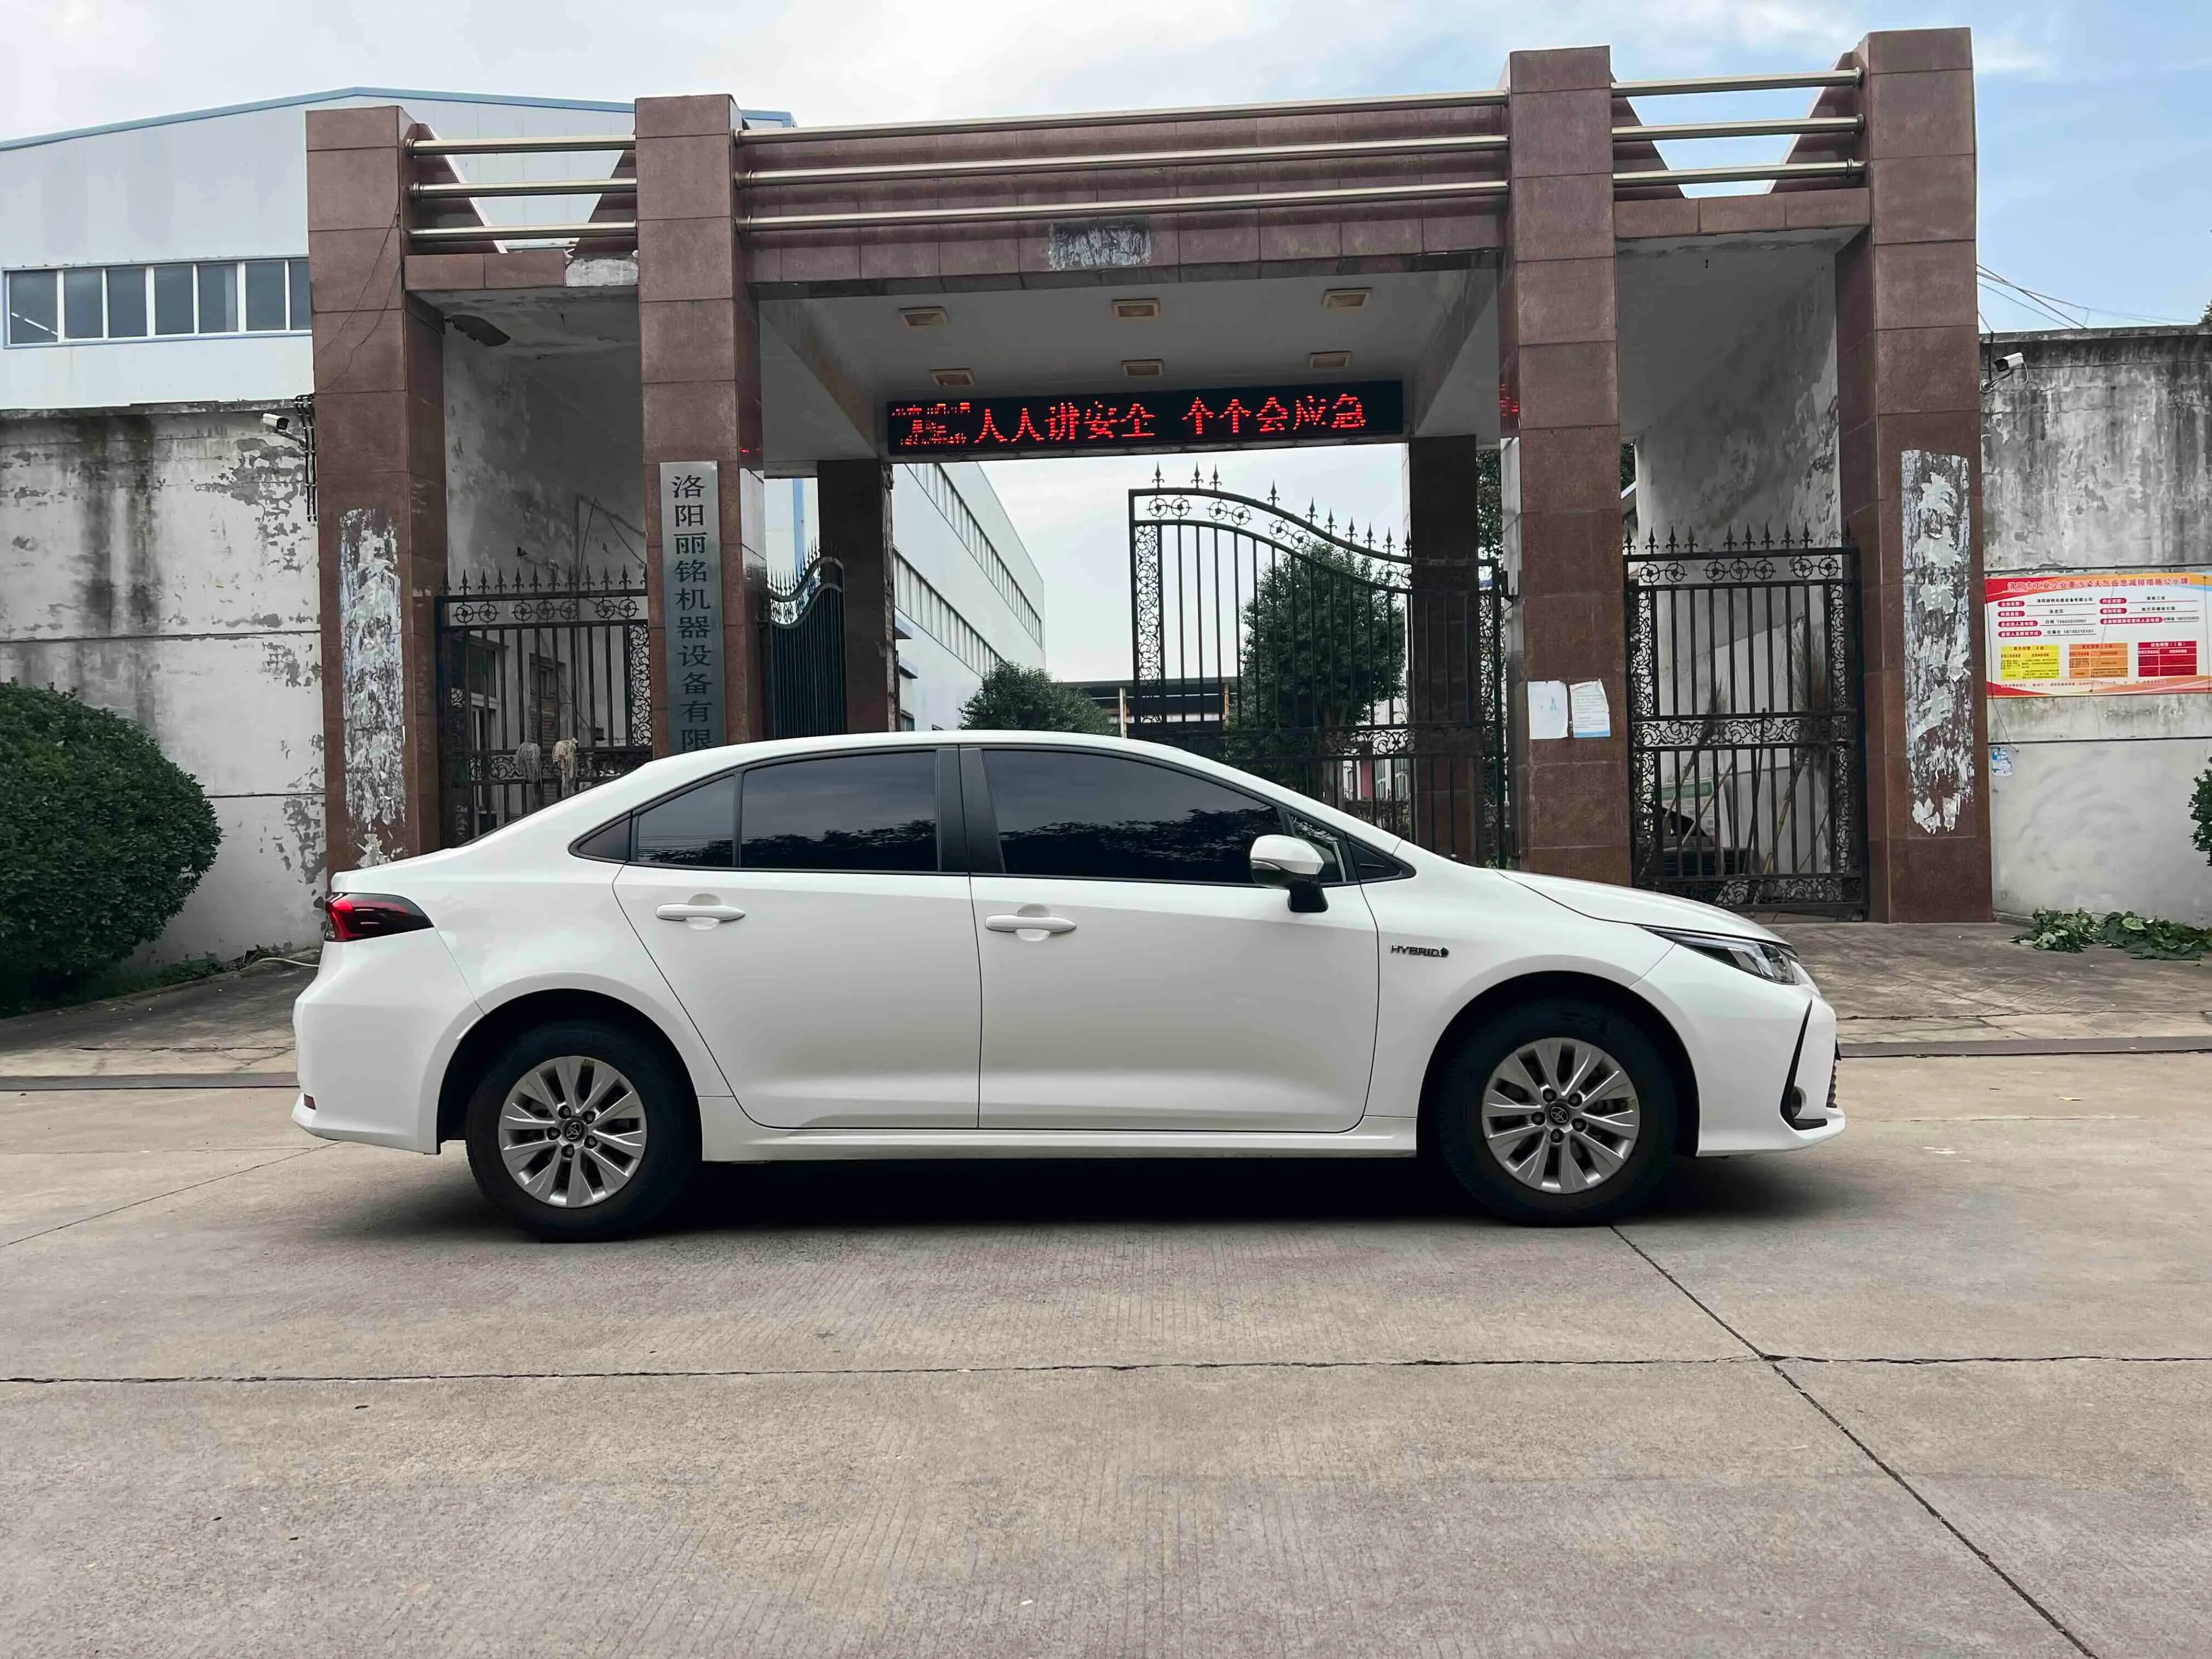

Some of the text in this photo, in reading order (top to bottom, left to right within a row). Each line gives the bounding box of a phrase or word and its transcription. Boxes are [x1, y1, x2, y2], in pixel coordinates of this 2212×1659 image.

[974, 401, 1156, 443] 人人讲安全
[1181, 393, 1367, 434] 个个会应急
[671, 474, 713, 751] 洛阳丽铭机器设备有限
[1391, 945, 1440, 957] HYBRID
